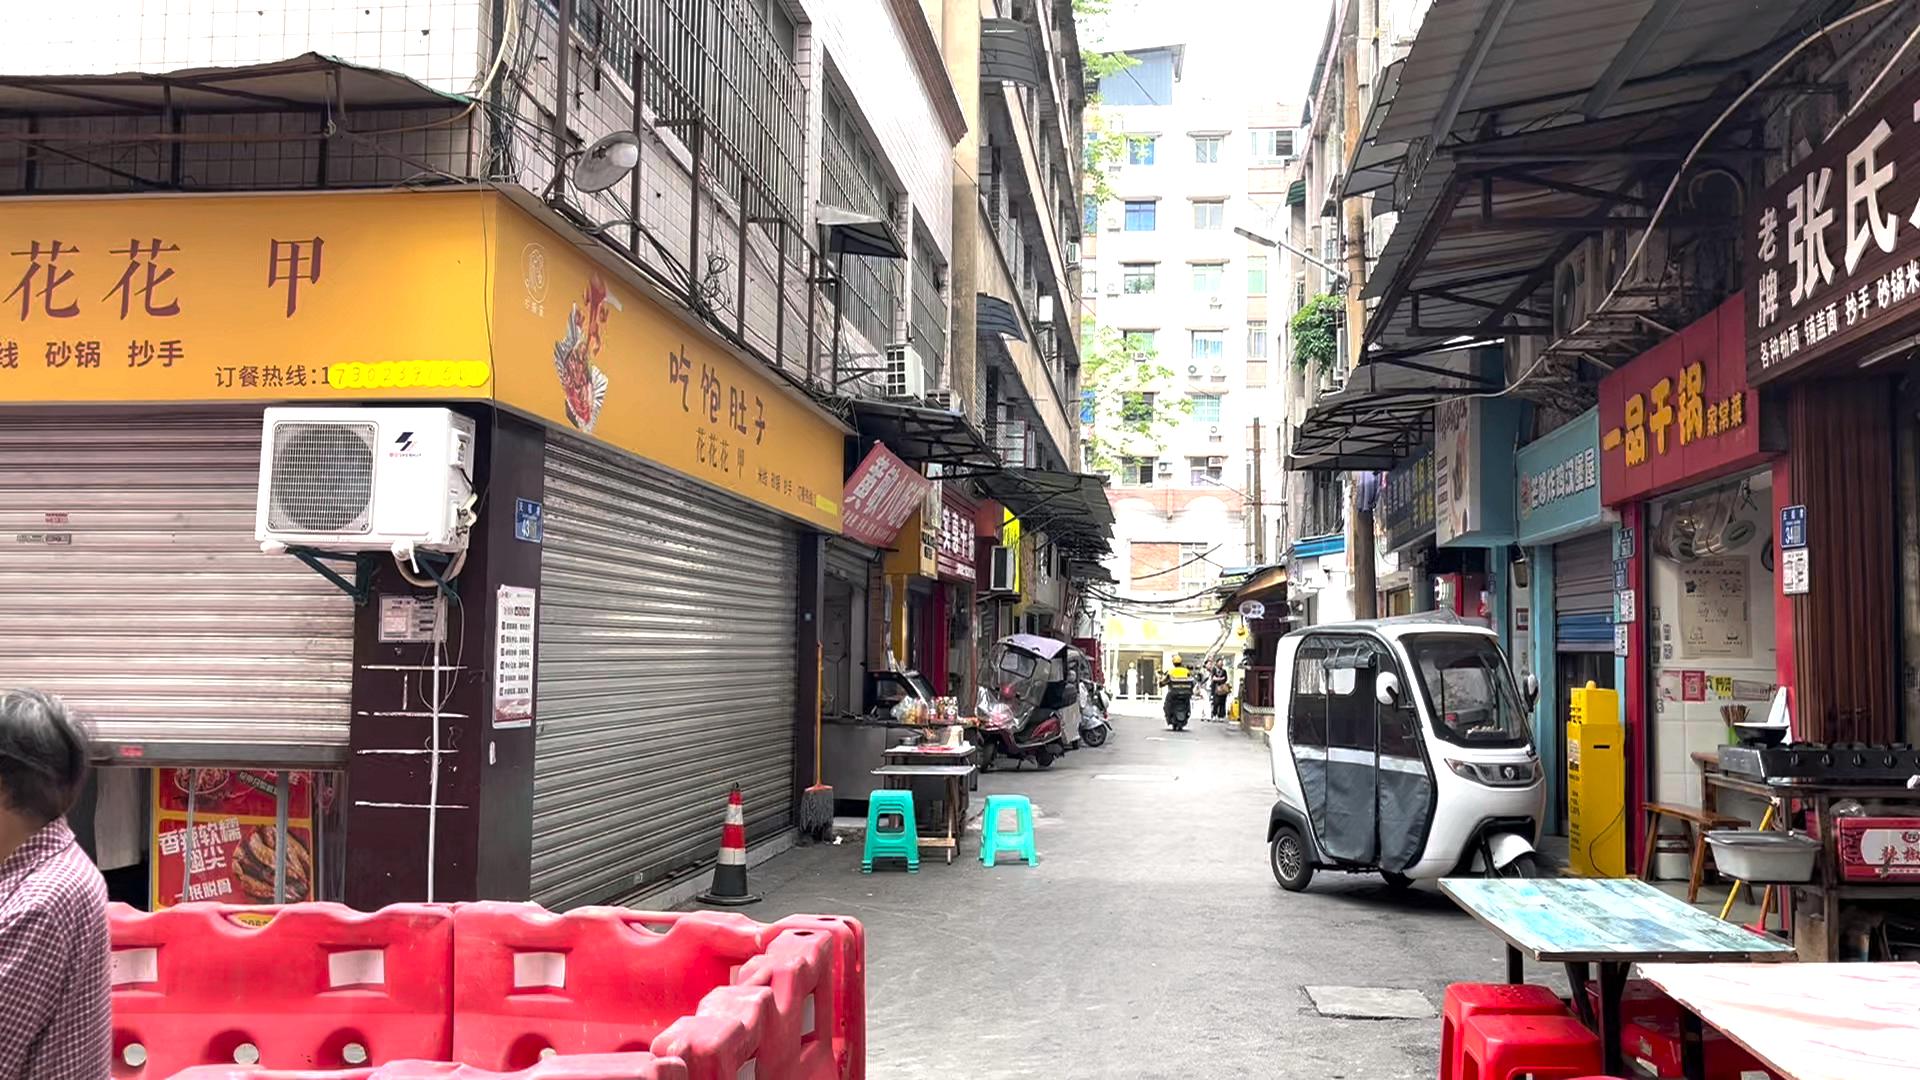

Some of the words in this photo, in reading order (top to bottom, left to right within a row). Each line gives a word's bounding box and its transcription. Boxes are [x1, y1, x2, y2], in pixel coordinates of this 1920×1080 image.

[1787, 97, 1920, 307] 张氏
[4, 237, 182, 322] 花花
[268, 236, 325, 319] 甲
[1757, 207, 1779, 328] 老牌
[1760, 324, 1800, 369] 各种粉面
[1804, 302, 1838, 346] 铺盖面
[1845, 284, 1871, 327] 抄手
[1877, 259, 1920, 309] 砂锅米
[46, 340, 101, 369] 砂锅
[128, 340, 185, 368] 抄手
[669, 343, 766, 446] 吃饱肚子
[1602, 361, 1703, 468] 一品干锅
